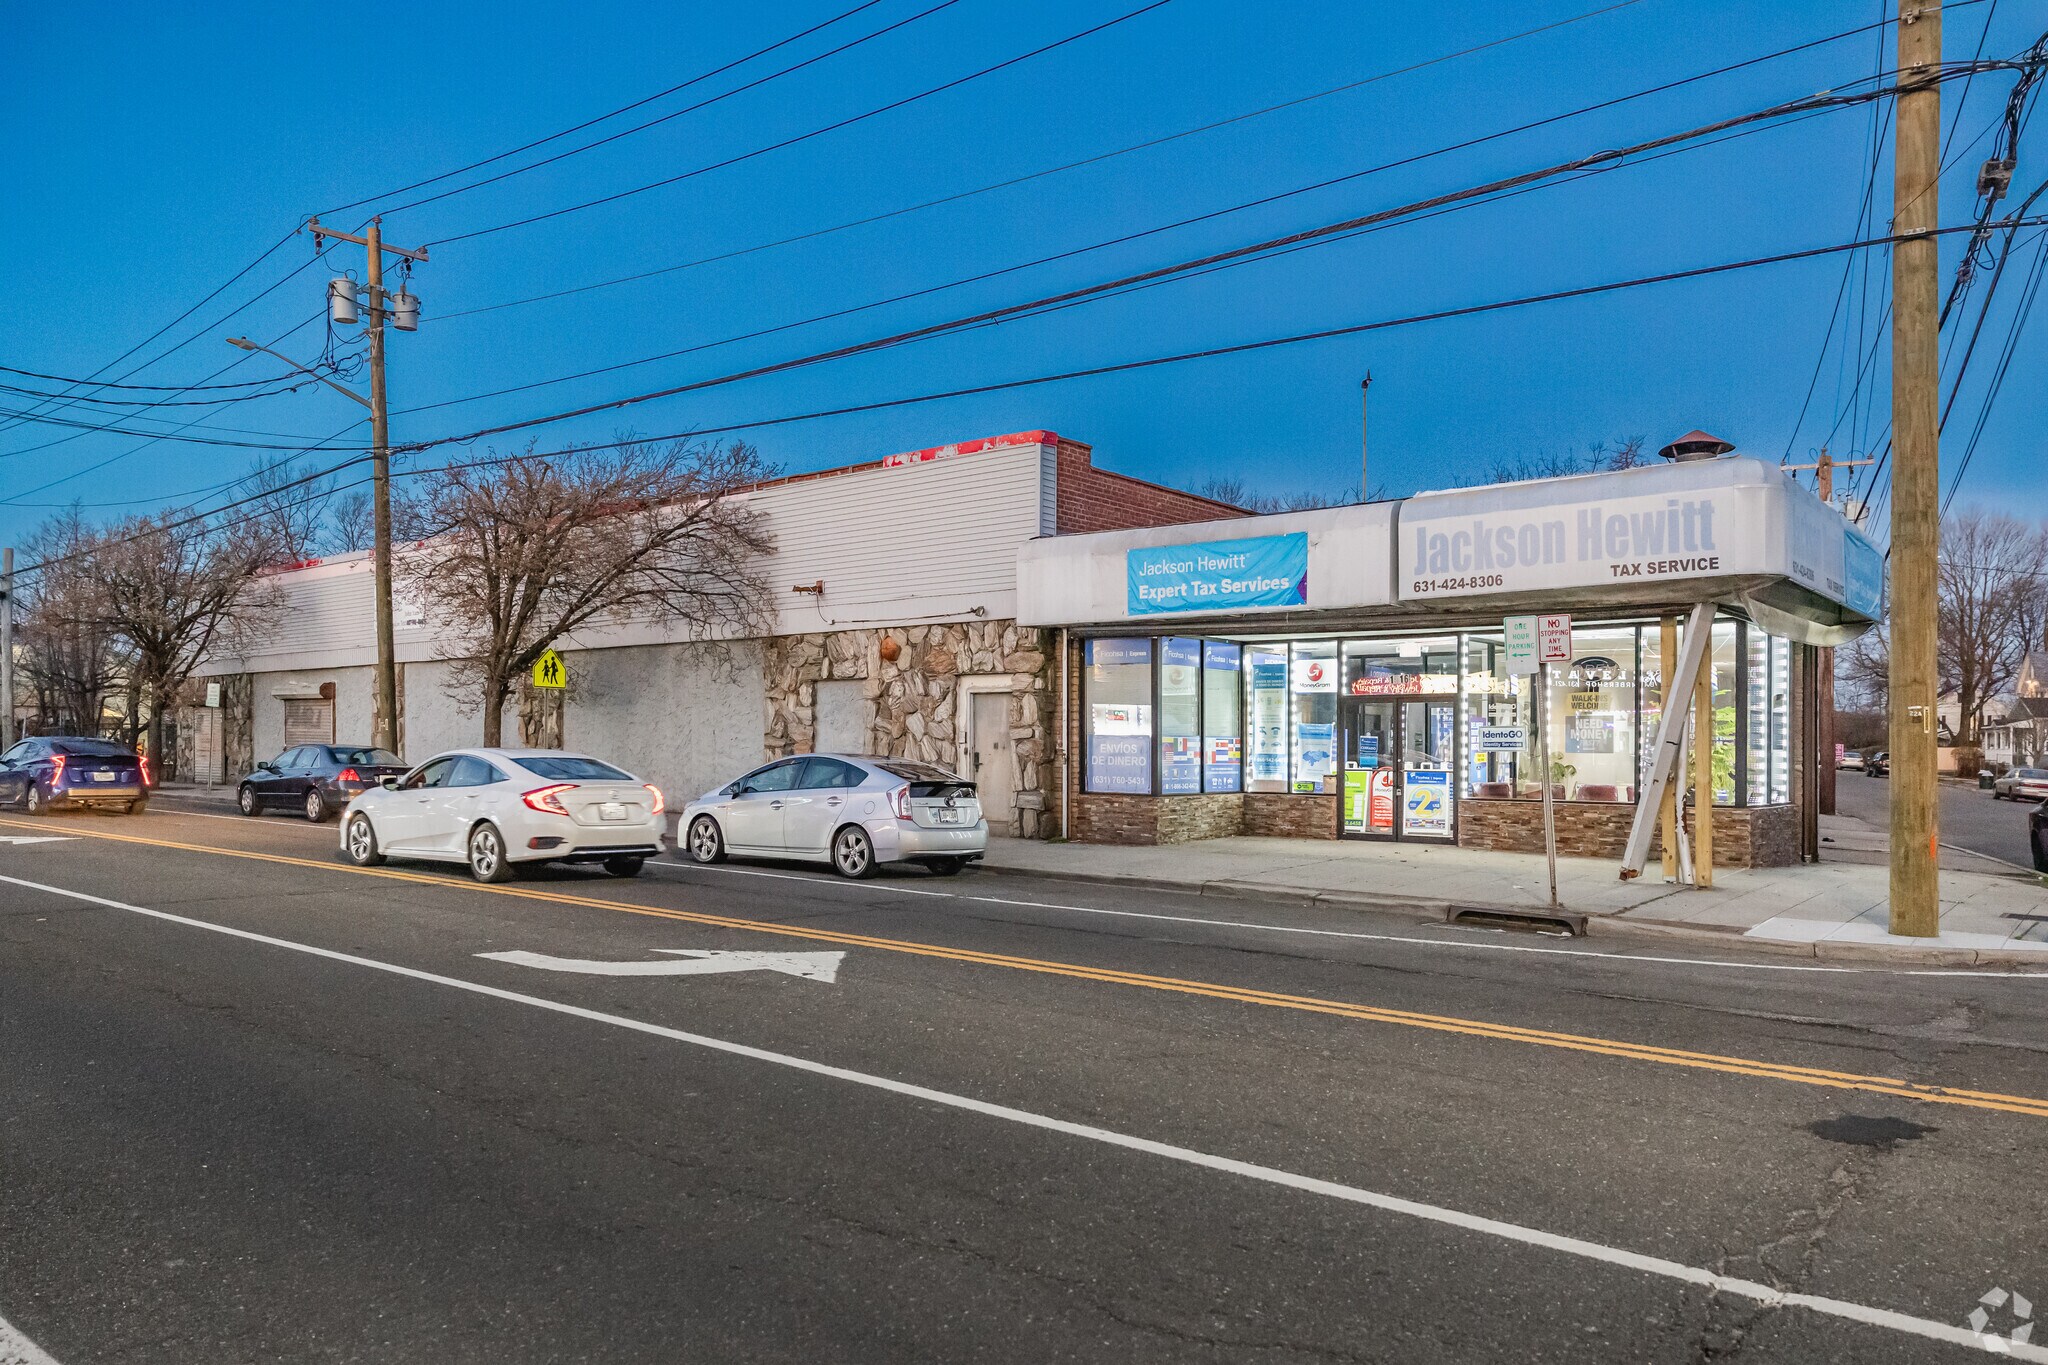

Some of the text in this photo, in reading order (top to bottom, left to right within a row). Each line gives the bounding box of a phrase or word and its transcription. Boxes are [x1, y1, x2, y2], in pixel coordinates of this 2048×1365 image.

[1413, 499, 1716, 576] Jackson Hewitt
[1139, 554, 1246, 576] Jackson Hewitt
[1610, 556, 1719, 578] TAX SERVICE
[1139, 576, 1290, 602] Expert Tax Services
[1413, 574, 1503, 593] 631-424-8306
[1547, 619, 1560, 628] NO
[1540, 629, 1569, 637] STOPPING
[1299, 682, 1331, 691] MoneyGram
[1576, 718, 1604, 729] NEED
[1483, 730, 1523, 739] IdentoGO
[1570, 728, 1608, 739] MONEY
[1100, 741, 1138, 754] ENVÍOS
[1091, 756, 1147, 766] DE DINERO
[1092, 775, 1145, 785] (631) 760-5431
[1415, 789, 1431, 815] 2
